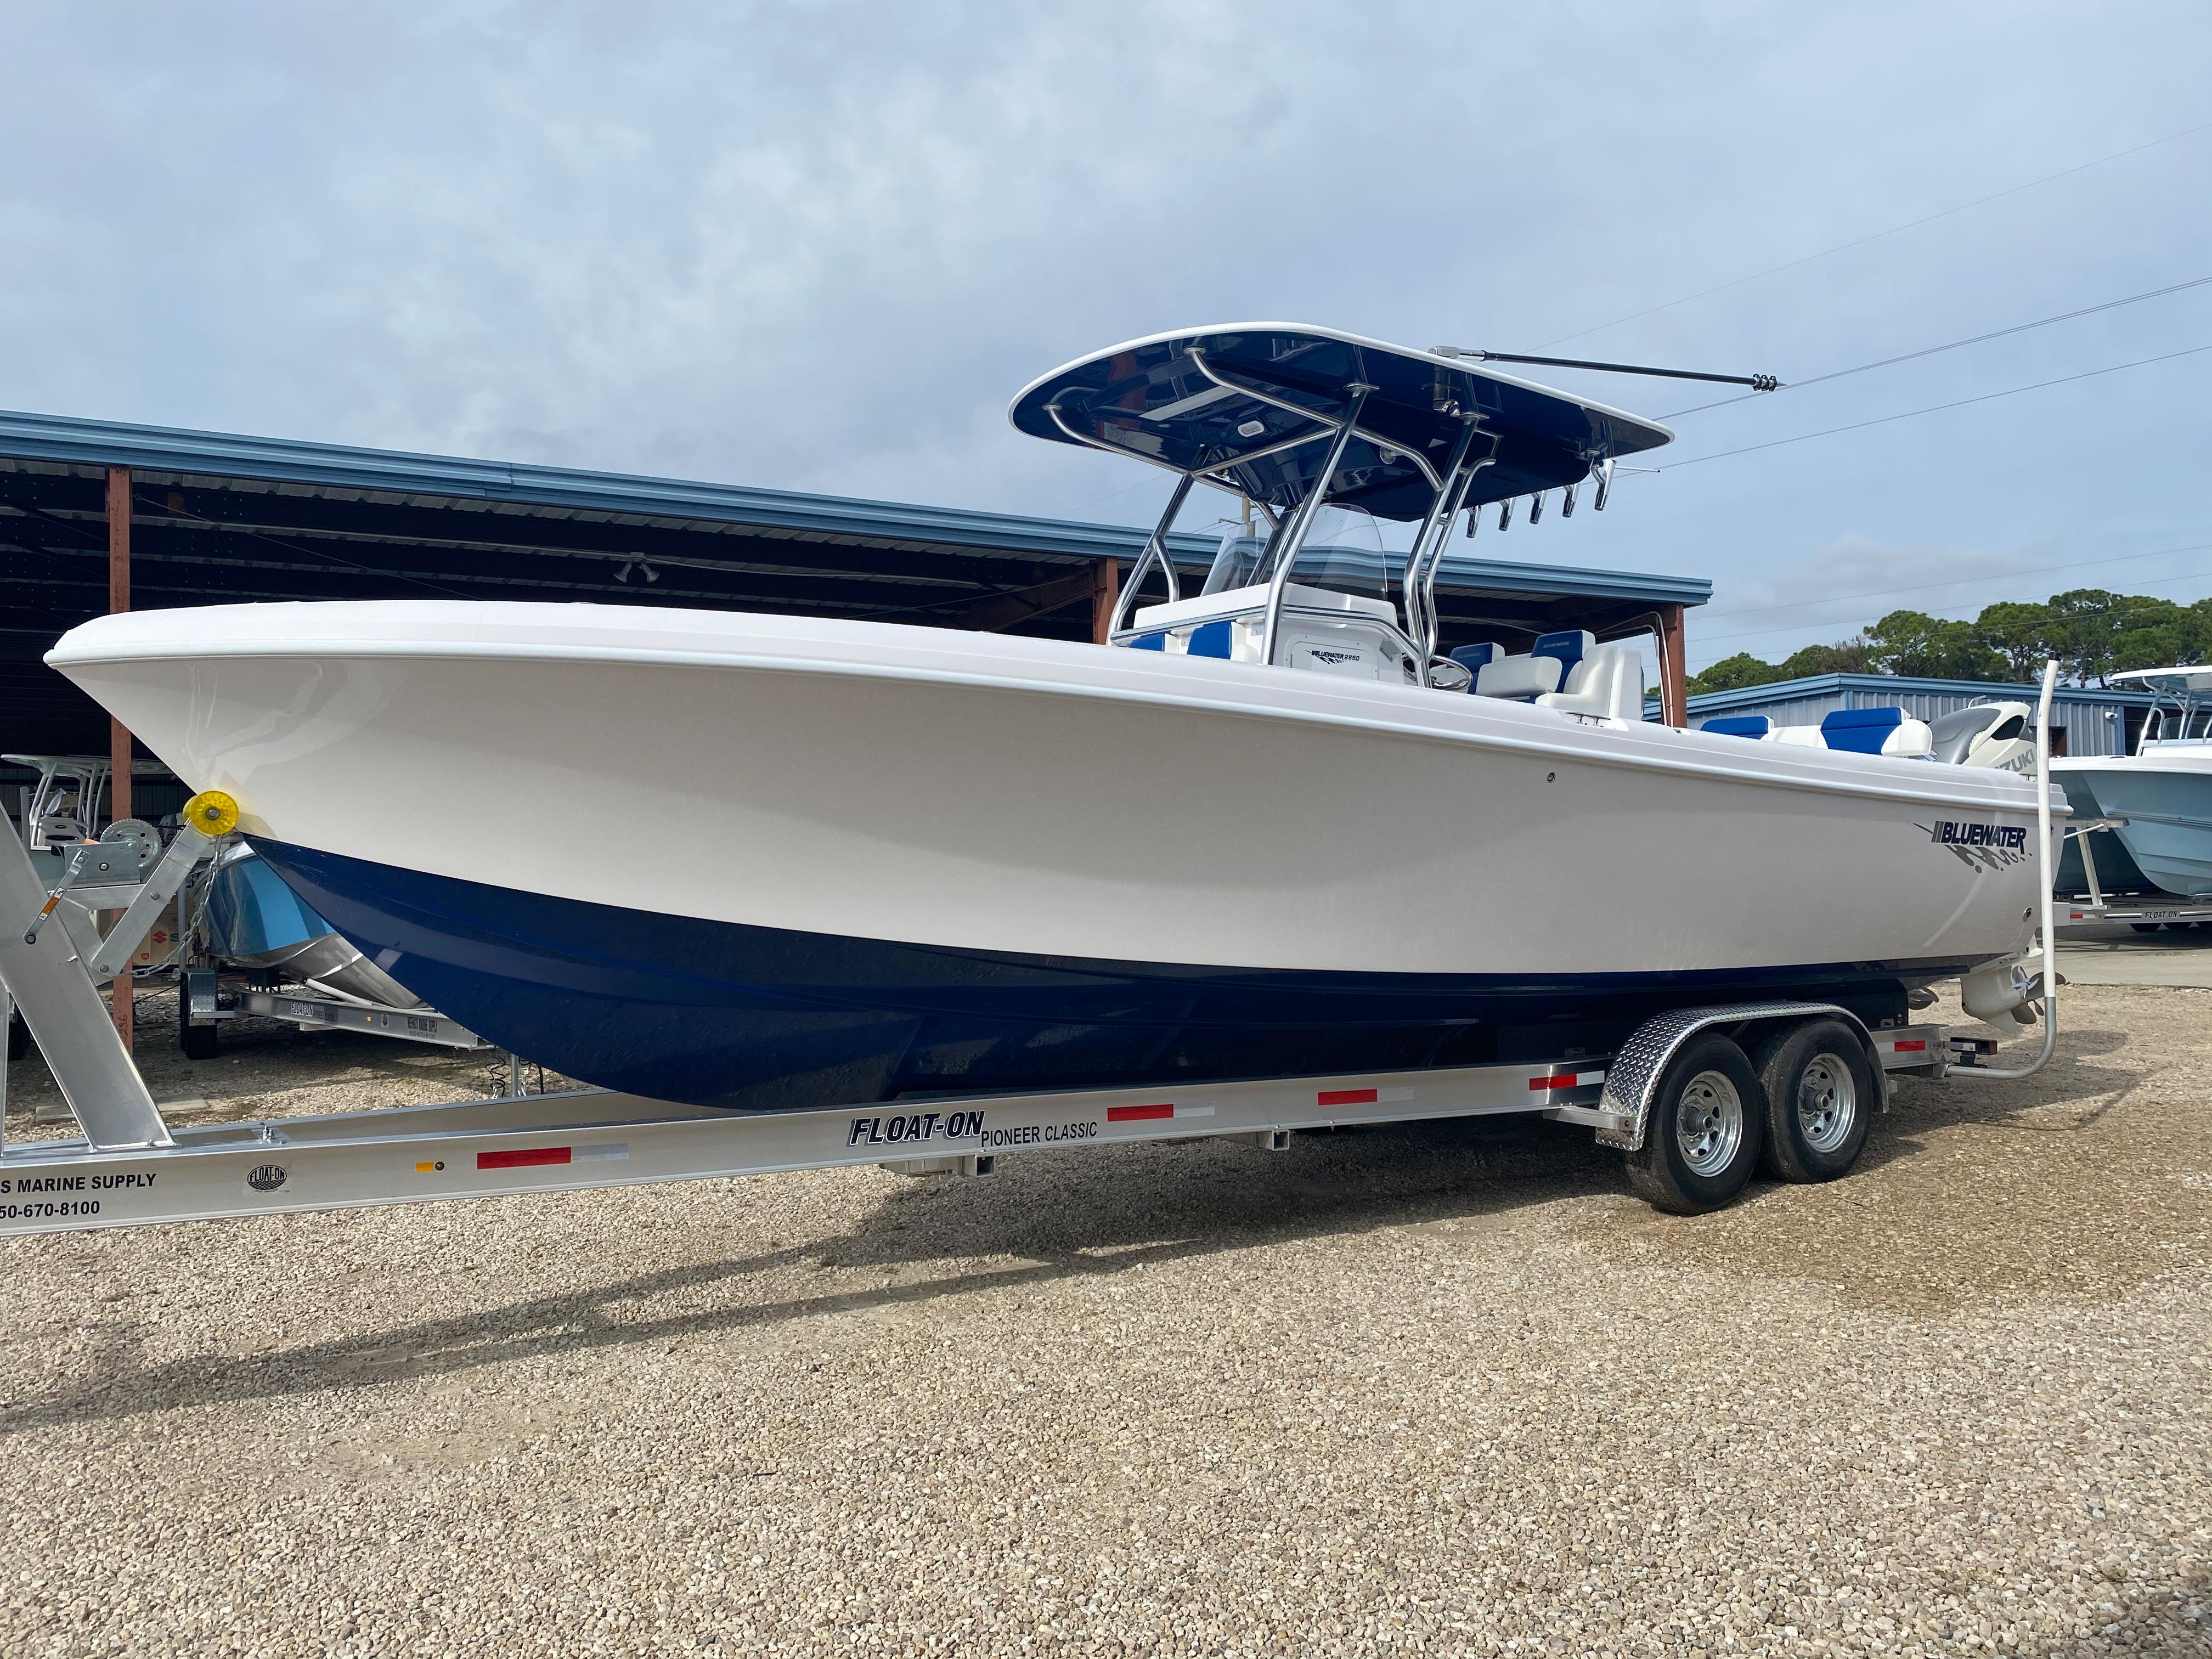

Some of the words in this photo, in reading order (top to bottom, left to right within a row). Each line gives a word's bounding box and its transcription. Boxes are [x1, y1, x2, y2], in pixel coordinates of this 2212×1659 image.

[1315, 651, 1344, 661] BLUEWATER
[1994, 749, 2035, 772] ZUKI
[1940, 822, 2027, 855] BLUEWATER
[848, 1110, 986, 1147] FLOAT-ON
[981, 1126, 1040, 1148] PIONEER
[1045, 1121, 1098, 1141] CLASSIC
[18, 1177, 86, 1193] MARINE
[91, 1173, 157, 1189] SUPPLY
[250, 1166, 285, 1182] FLOAT-ON
